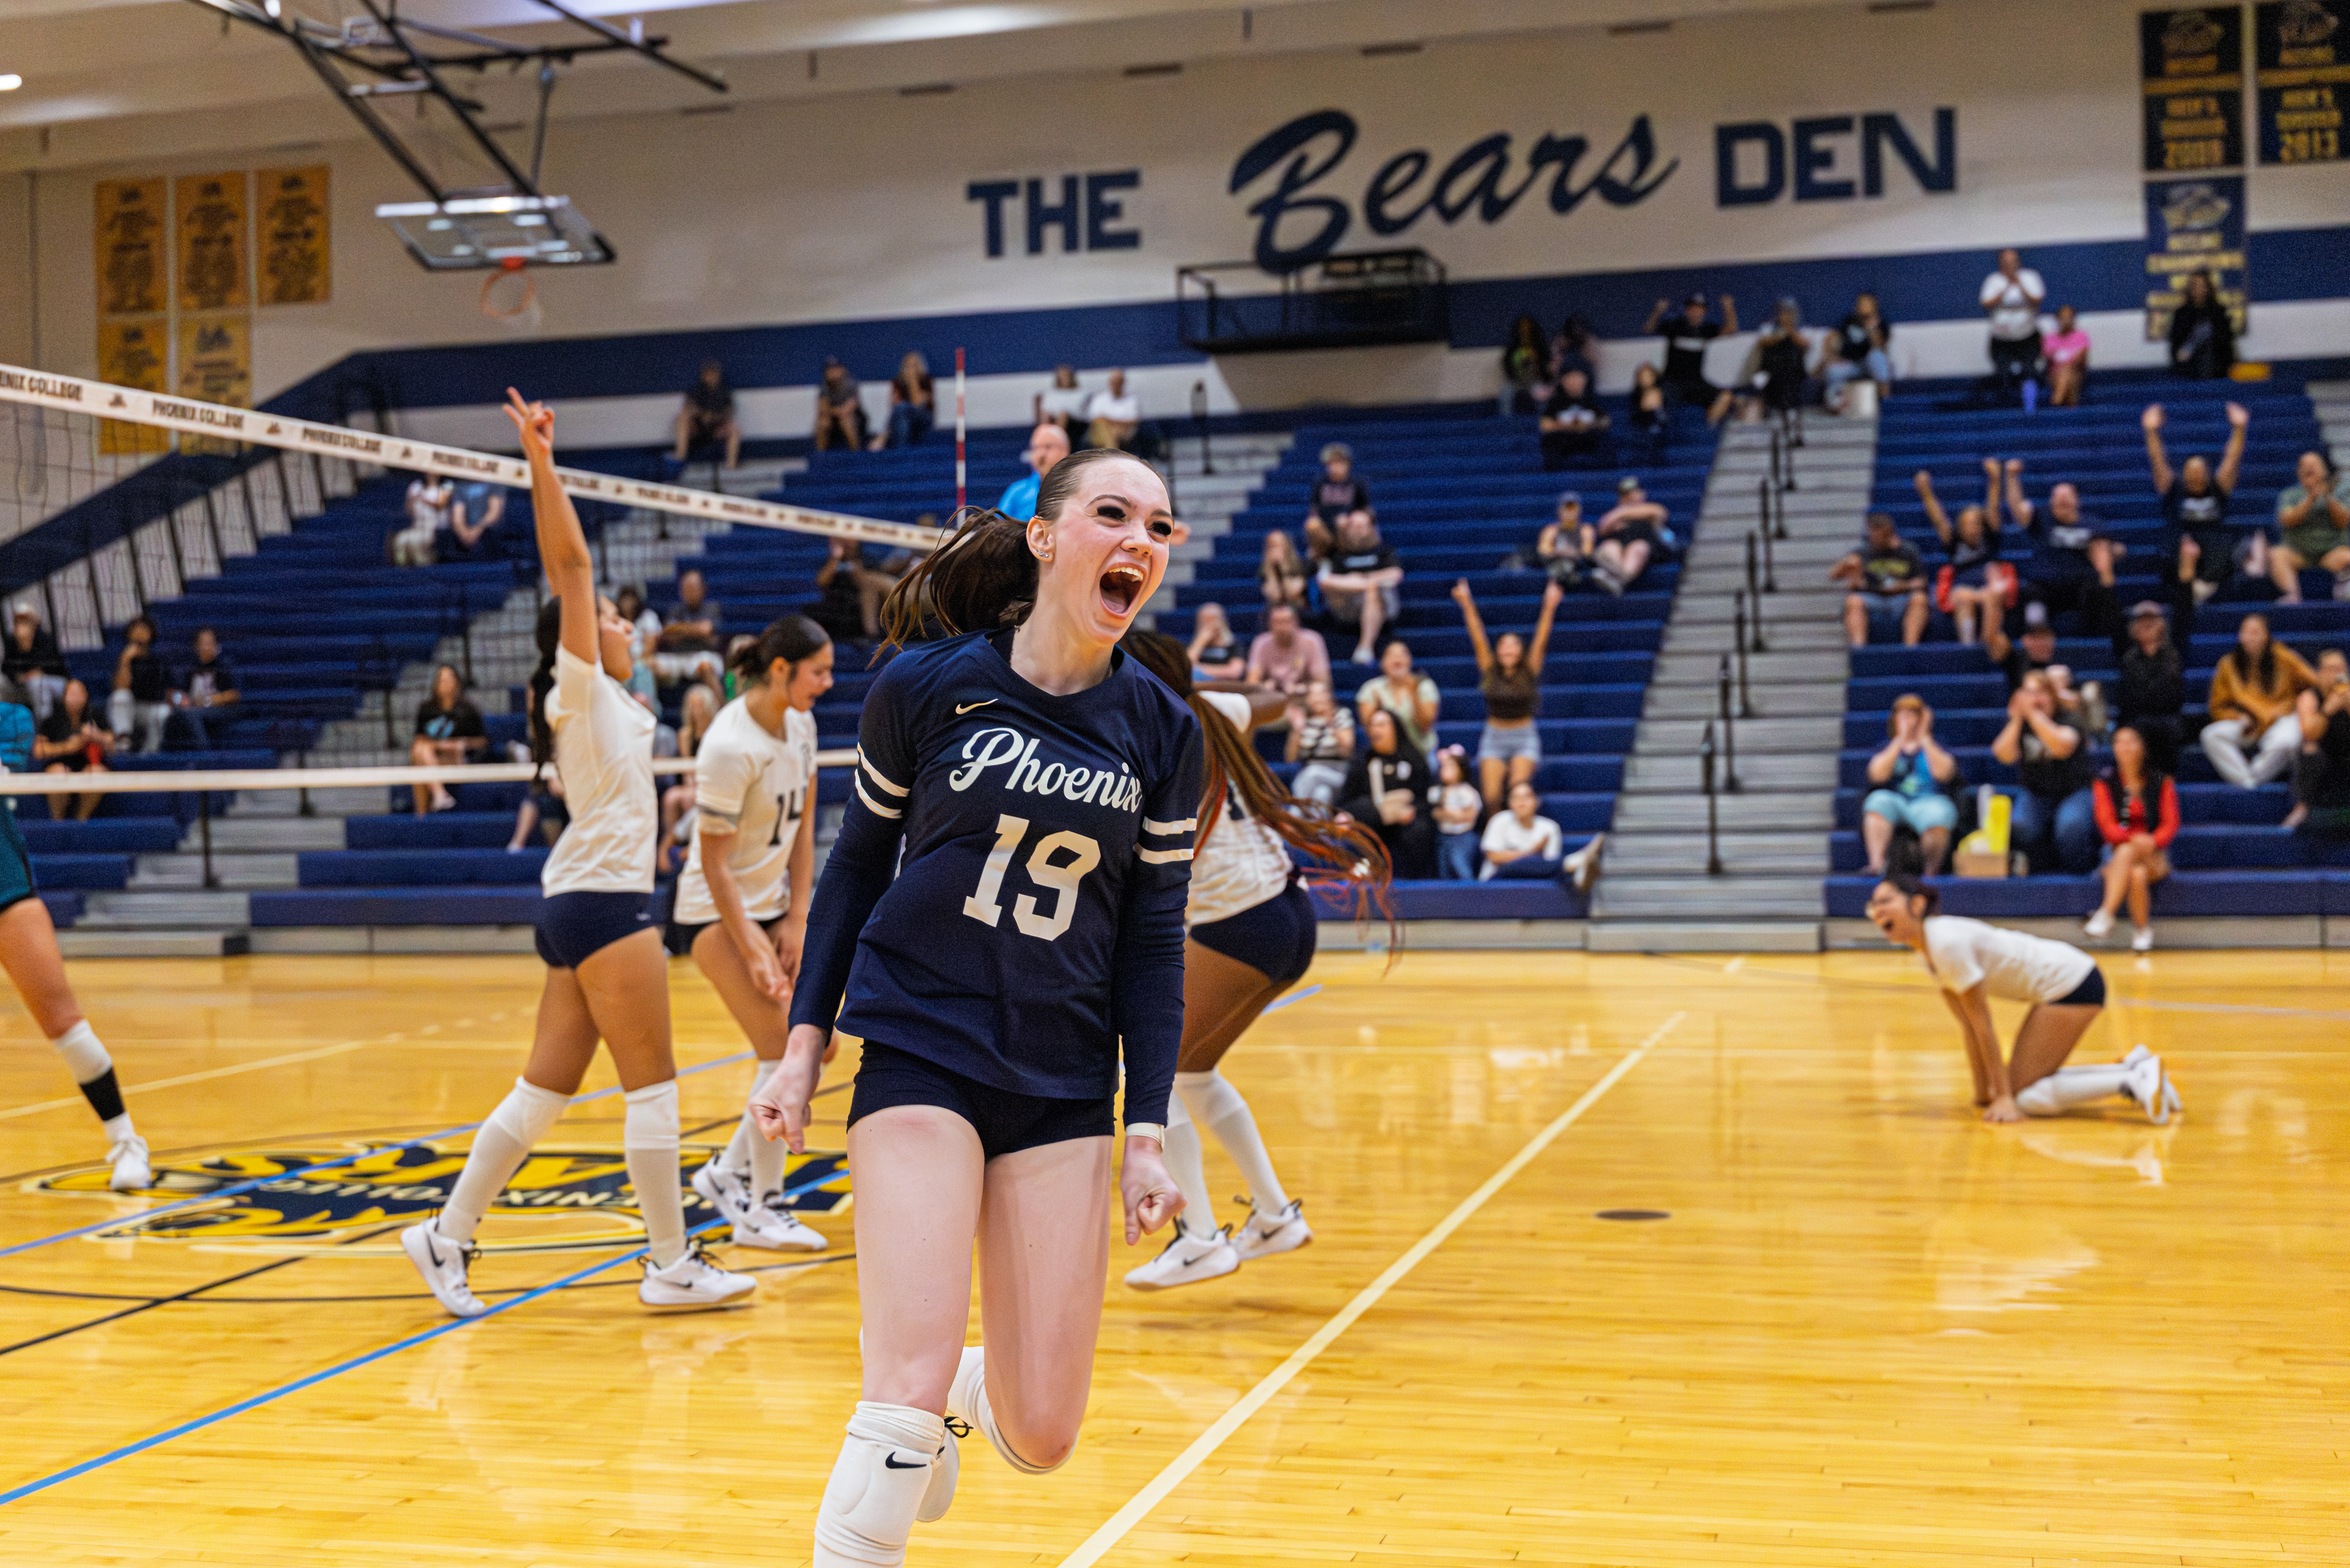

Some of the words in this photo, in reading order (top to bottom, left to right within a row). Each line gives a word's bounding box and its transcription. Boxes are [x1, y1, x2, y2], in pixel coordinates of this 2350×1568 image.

[966, 169, 1141, 258] THE
[1229, 109, 1679, 276] Bears
[1714, 107, 1957, 209] DEN
[29, 376, 82, 401] COLLEGE
[153, 400, 196, 420] PHOENIX
[200, 408, 244, 430] COLLEGE
[949, 727, 1143, 814] Phoenix
[962, 813, 1101, 942] 19
